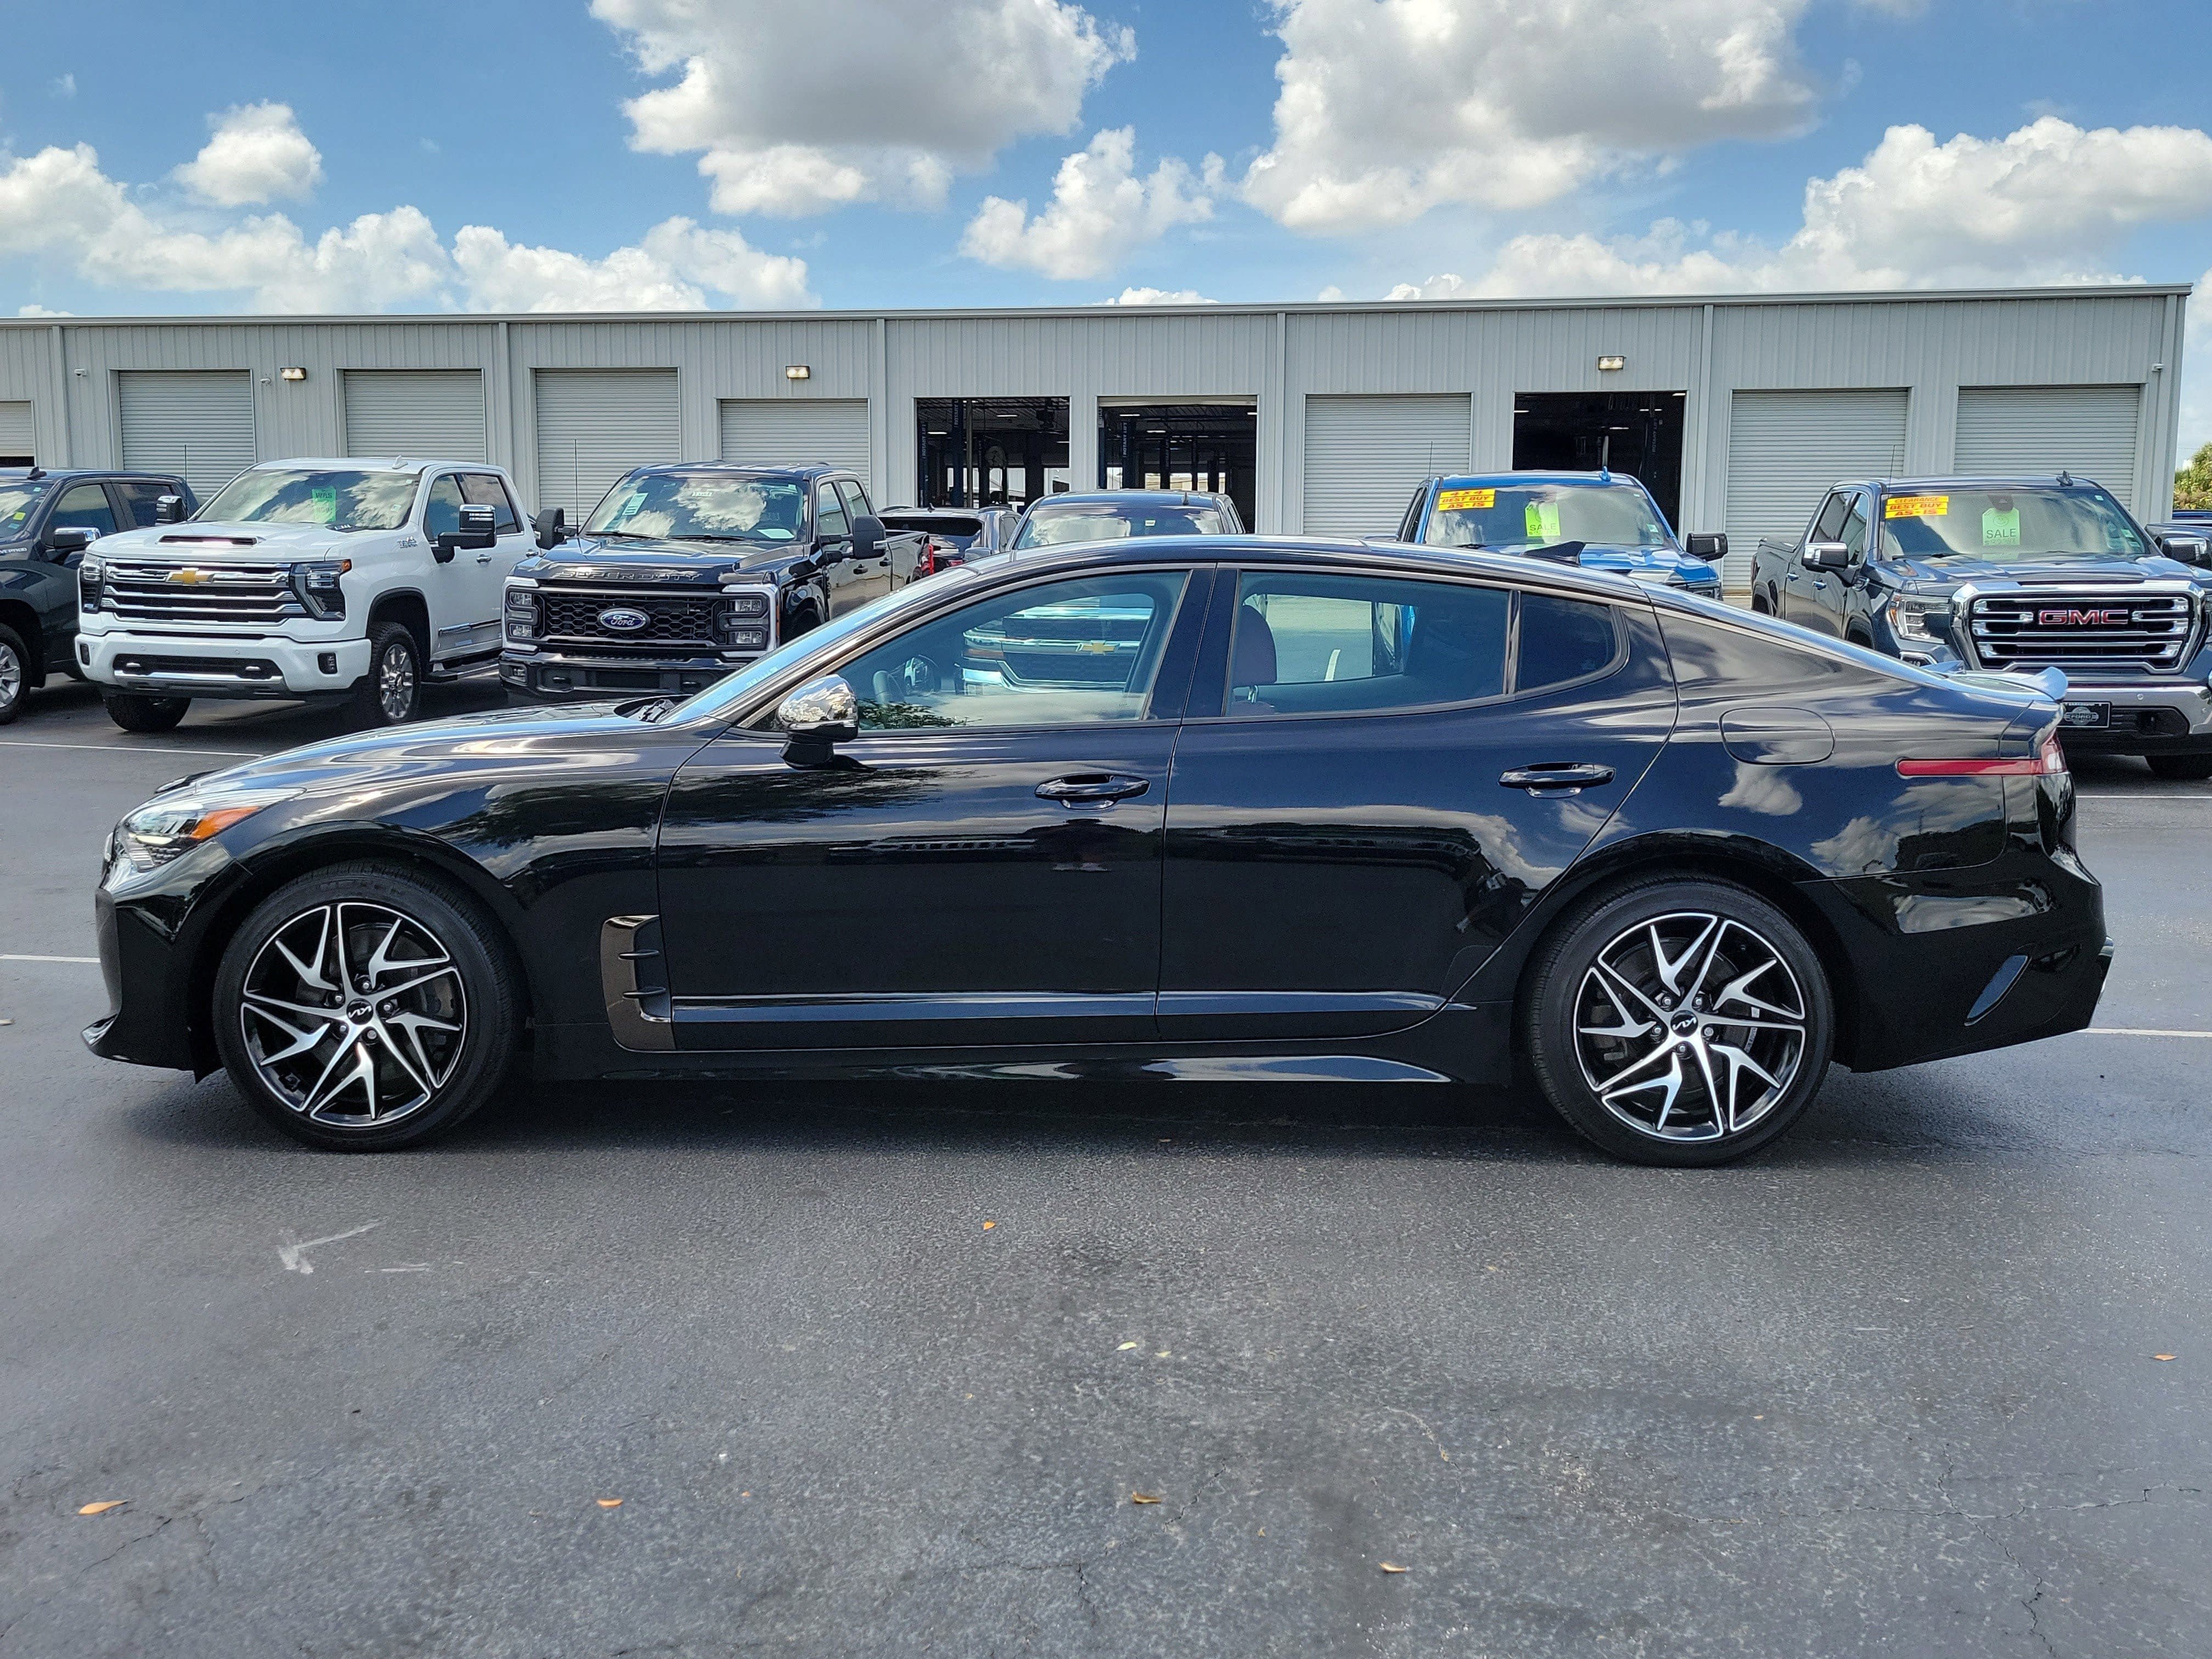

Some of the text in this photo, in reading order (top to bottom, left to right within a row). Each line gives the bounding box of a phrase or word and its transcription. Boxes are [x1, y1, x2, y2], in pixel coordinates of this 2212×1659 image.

[1530, 523, 1556, 531] SALE
[1986, 528, 2017, 539] SALE
[557, 571, 703, 581] SUPER DUTY
[610, 615, 635, 626] Ford
[2039, 609, 2128, 625] GMC
